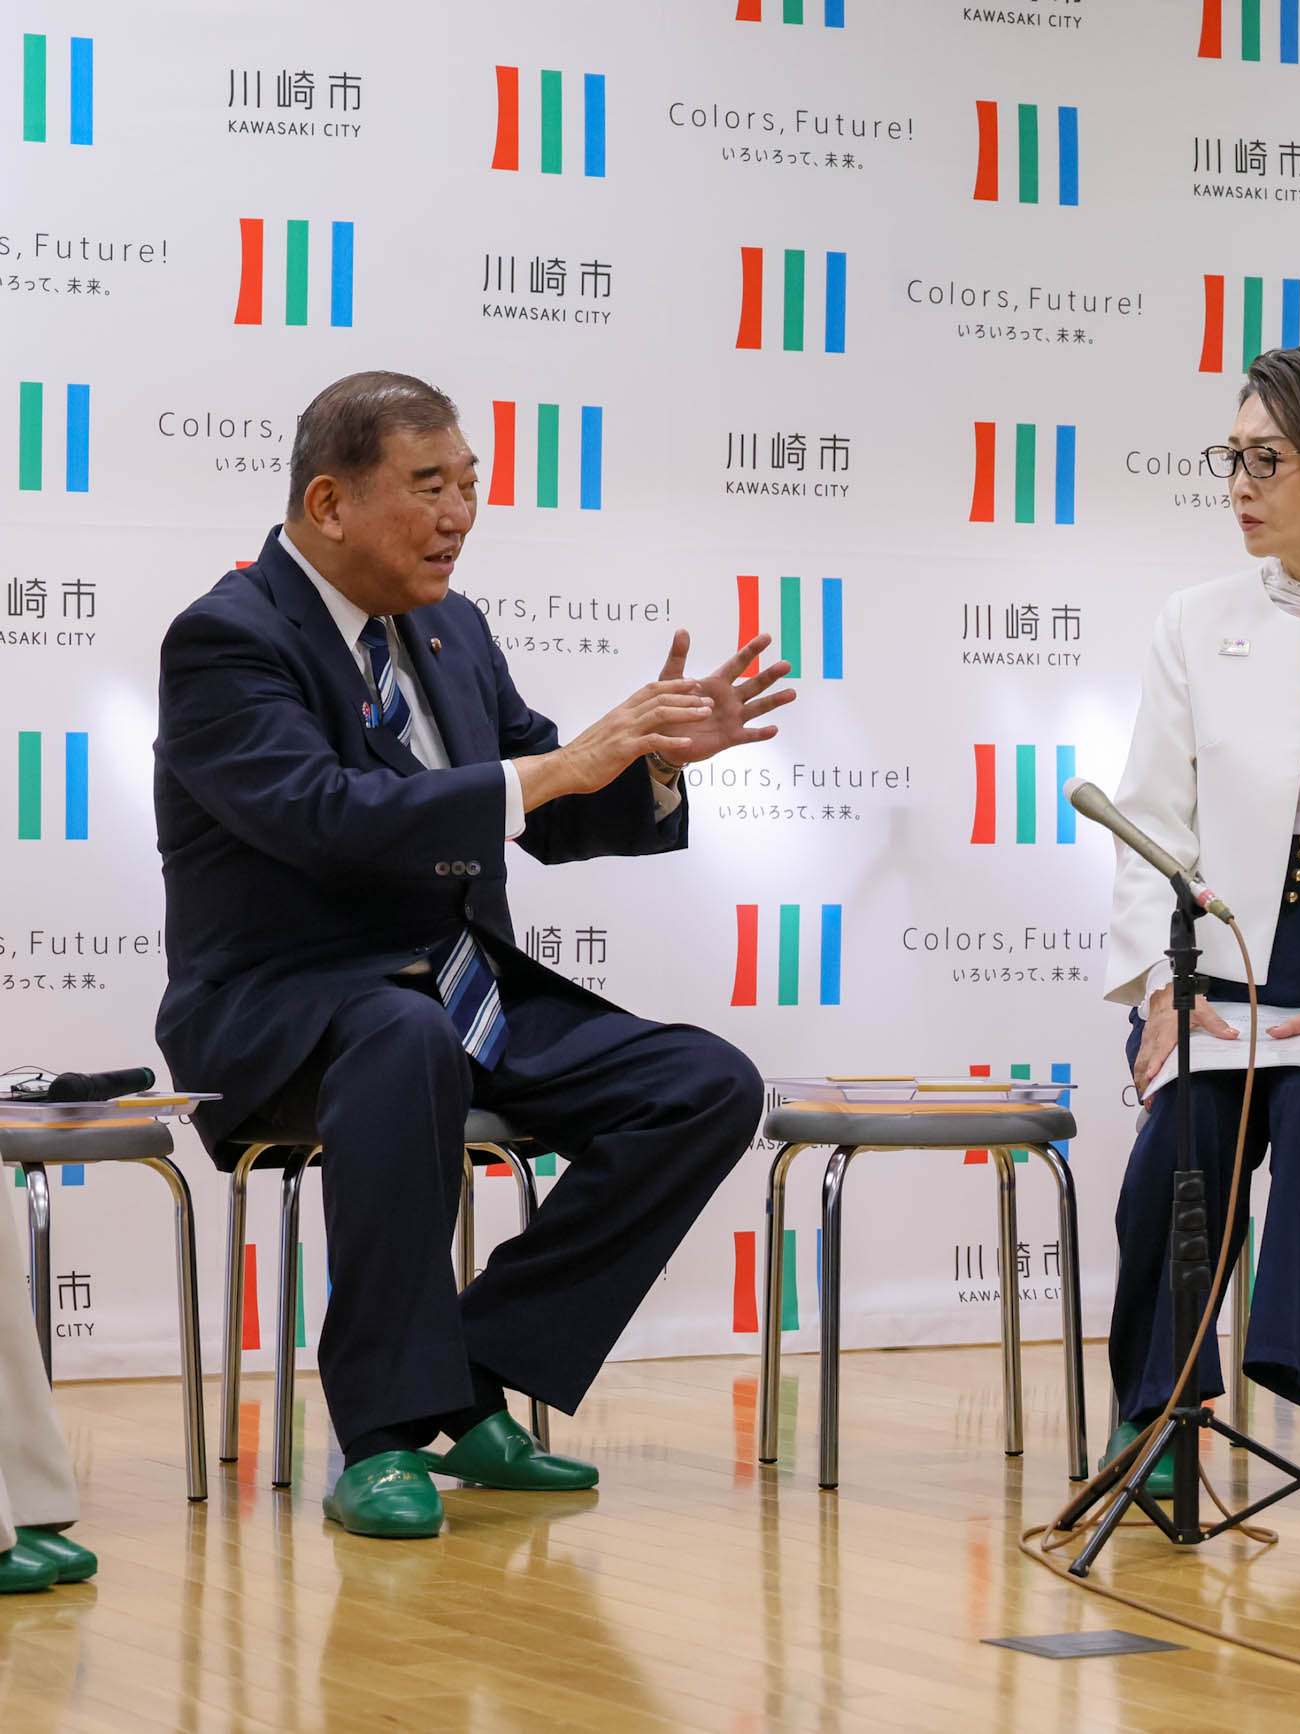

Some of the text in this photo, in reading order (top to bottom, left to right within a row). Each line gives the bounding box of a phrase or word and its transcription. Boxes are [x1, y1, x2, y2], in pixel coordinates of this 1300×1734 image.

[963, 7, 1082, 29] KAWASAKI CITY
[228, 69, 362, 112] 川崎市
[228, 119, 361, 138] KAWASAKI CITY
[722, 147, 864, 170] いろいろって、未来。
[1193, 183, 1268, 201] KAWASAKI
[0, 275, 111, 296] ろって、未来。
[482, 254, 612, 299] 川崎市
[482, 304, 611, 325] KAWASAKI CITY
[957, 324, 1094, 345] いろいろって、未来。
[158, 411, 302, 443] Colors,
[725, 432, 851, 472] 川崎市
[215, 457, 290, 473] いろいろ
[726, 480, 849, 498] KAWASAKI CITY
[8, 577, 97, 619] 崎市
[962, 602, 1082, 642] 川崎市
[56, 631, 96, 646] CITY
[962, 651, 1081, 667] KAWASAKI CITY
[718, 803, 862, 821] いろいろって、未来。
[952, 965, 1089, 983] いろいろって、未来。
[958, 1288, 1038, 1303] KAWAKI
[56, 1322, 95, 1338] CITY
